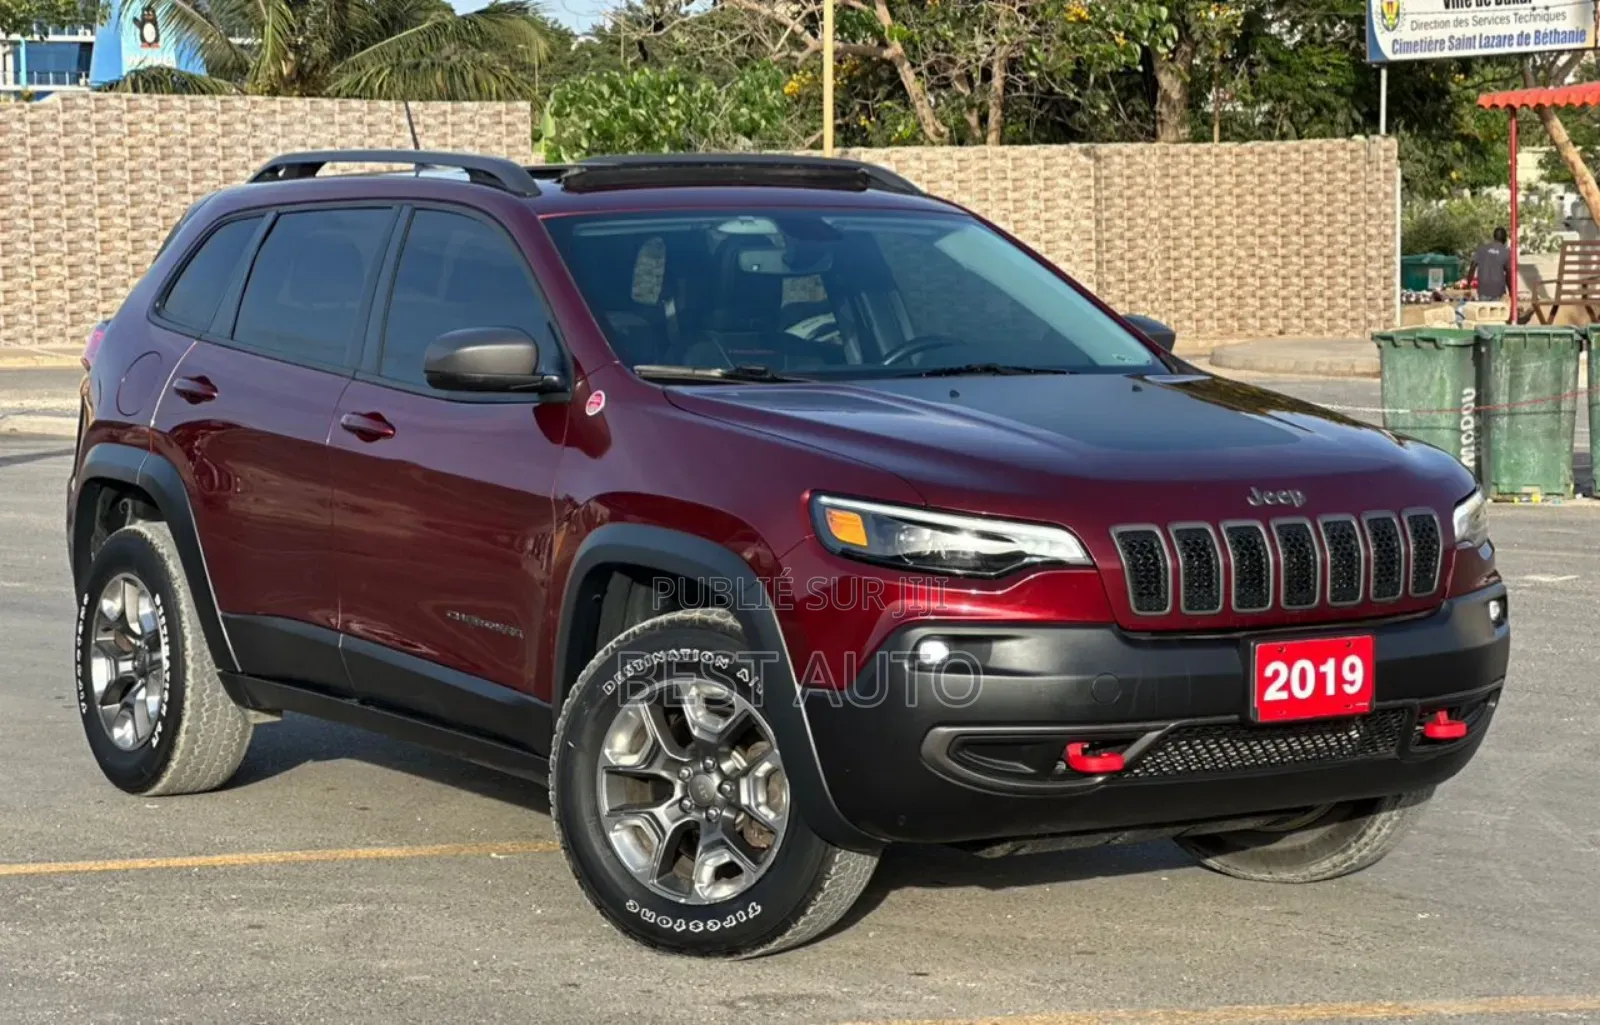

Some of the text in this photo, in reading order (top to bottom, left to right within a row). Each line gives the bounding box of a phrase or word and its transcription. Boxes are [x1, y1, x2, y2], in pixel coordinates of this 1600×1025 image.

[1410, 10, 1567, 31] Direction des Services Techniques
[1391, 26, 1587, 55] Cimetière Saint Lazare de Béthanie
[1246, 486, 1306, 508] Jeep
[602, 649, 731, 696] DESTINATION
[1263, 654, 1364, 702] 2019
[625, 899, 762, 933] Firestone
